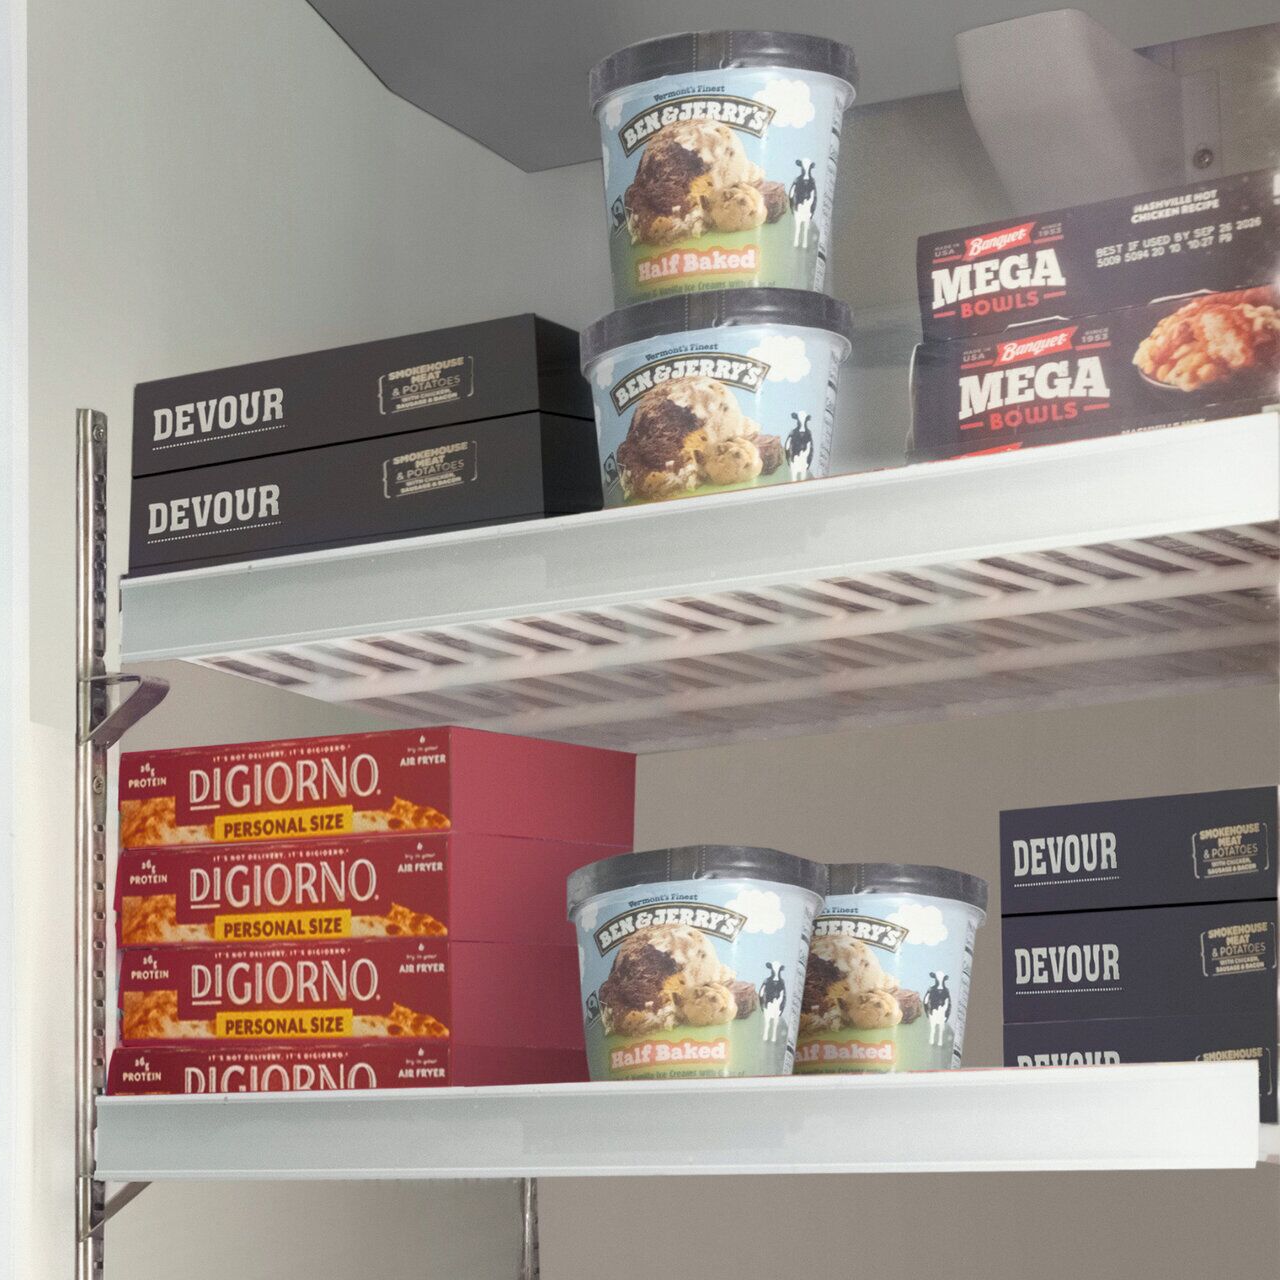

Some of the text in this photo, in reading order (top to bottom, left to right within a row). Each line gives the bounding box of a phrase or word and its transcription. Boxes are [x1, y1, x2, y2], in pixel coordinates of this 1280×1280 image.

[623, 100, 770, 149] BEN JERRY'S
[1130, 199, 1220, 225] CHICKEN RECIPE
[1133, 189, 1218, 214] NASHVILLE HOT
[969, 229, 1027, 258] Banquet
[1095, 233, 1171, 259] BEST USED
[638, 249, 756, 281] Half Baked
[931, 247, 1067, 310] MEGA
[960, 291, 1040, 318] BOWLS
[645, 344, 688, 362] Vermont's
[1000, 331, 1069, 363] Banquet
[388, 356, 465, 381] SMOKEHOUSE
[402, 375, 461, 395] POTATOES
[614, 358, 764, 407] BEN JERRY'S
[958, 356, 1111, 421] MEGA
[153, 388, 284, 441] DEVOUR
[989, 402, 1078, 430] BOWLS
[393, 441, 468, 465] SMOKEHOUSE
[406, 459, 465, 480] POTATOES
[148, 484, 280, 534] DEVOUR
[416, 753, 446, 766] FRYER
[128, 776, 167, 789] PROTEIN
[223, 812, 344, 839] PERSONAL SIZE
[1199, 822, 1260, 840] SMOKEHOUSE
[1012, 831, 1118, 877] DEVOUR
[1211, 843, 1259, 858] POTATOES
[129, 874, 168, 885] PROTEIN
[413, 861, 443, 873] FRYER
[223, 917, 343, 938] PERSONAL SIZE
[599, 906, 741, 948] BEN JERRY'S
[131, 969, 170, 981] PROTEIN
[416, 962, 446, 974] FRYER
[1014, 943, 1120, 985] DEVOUR
[225, 1016, 344, 1036] PERSONAL SIZE
[611, 1041, 726, 1069] Half Baked
[824, 1042, 893, 1061] Baked
